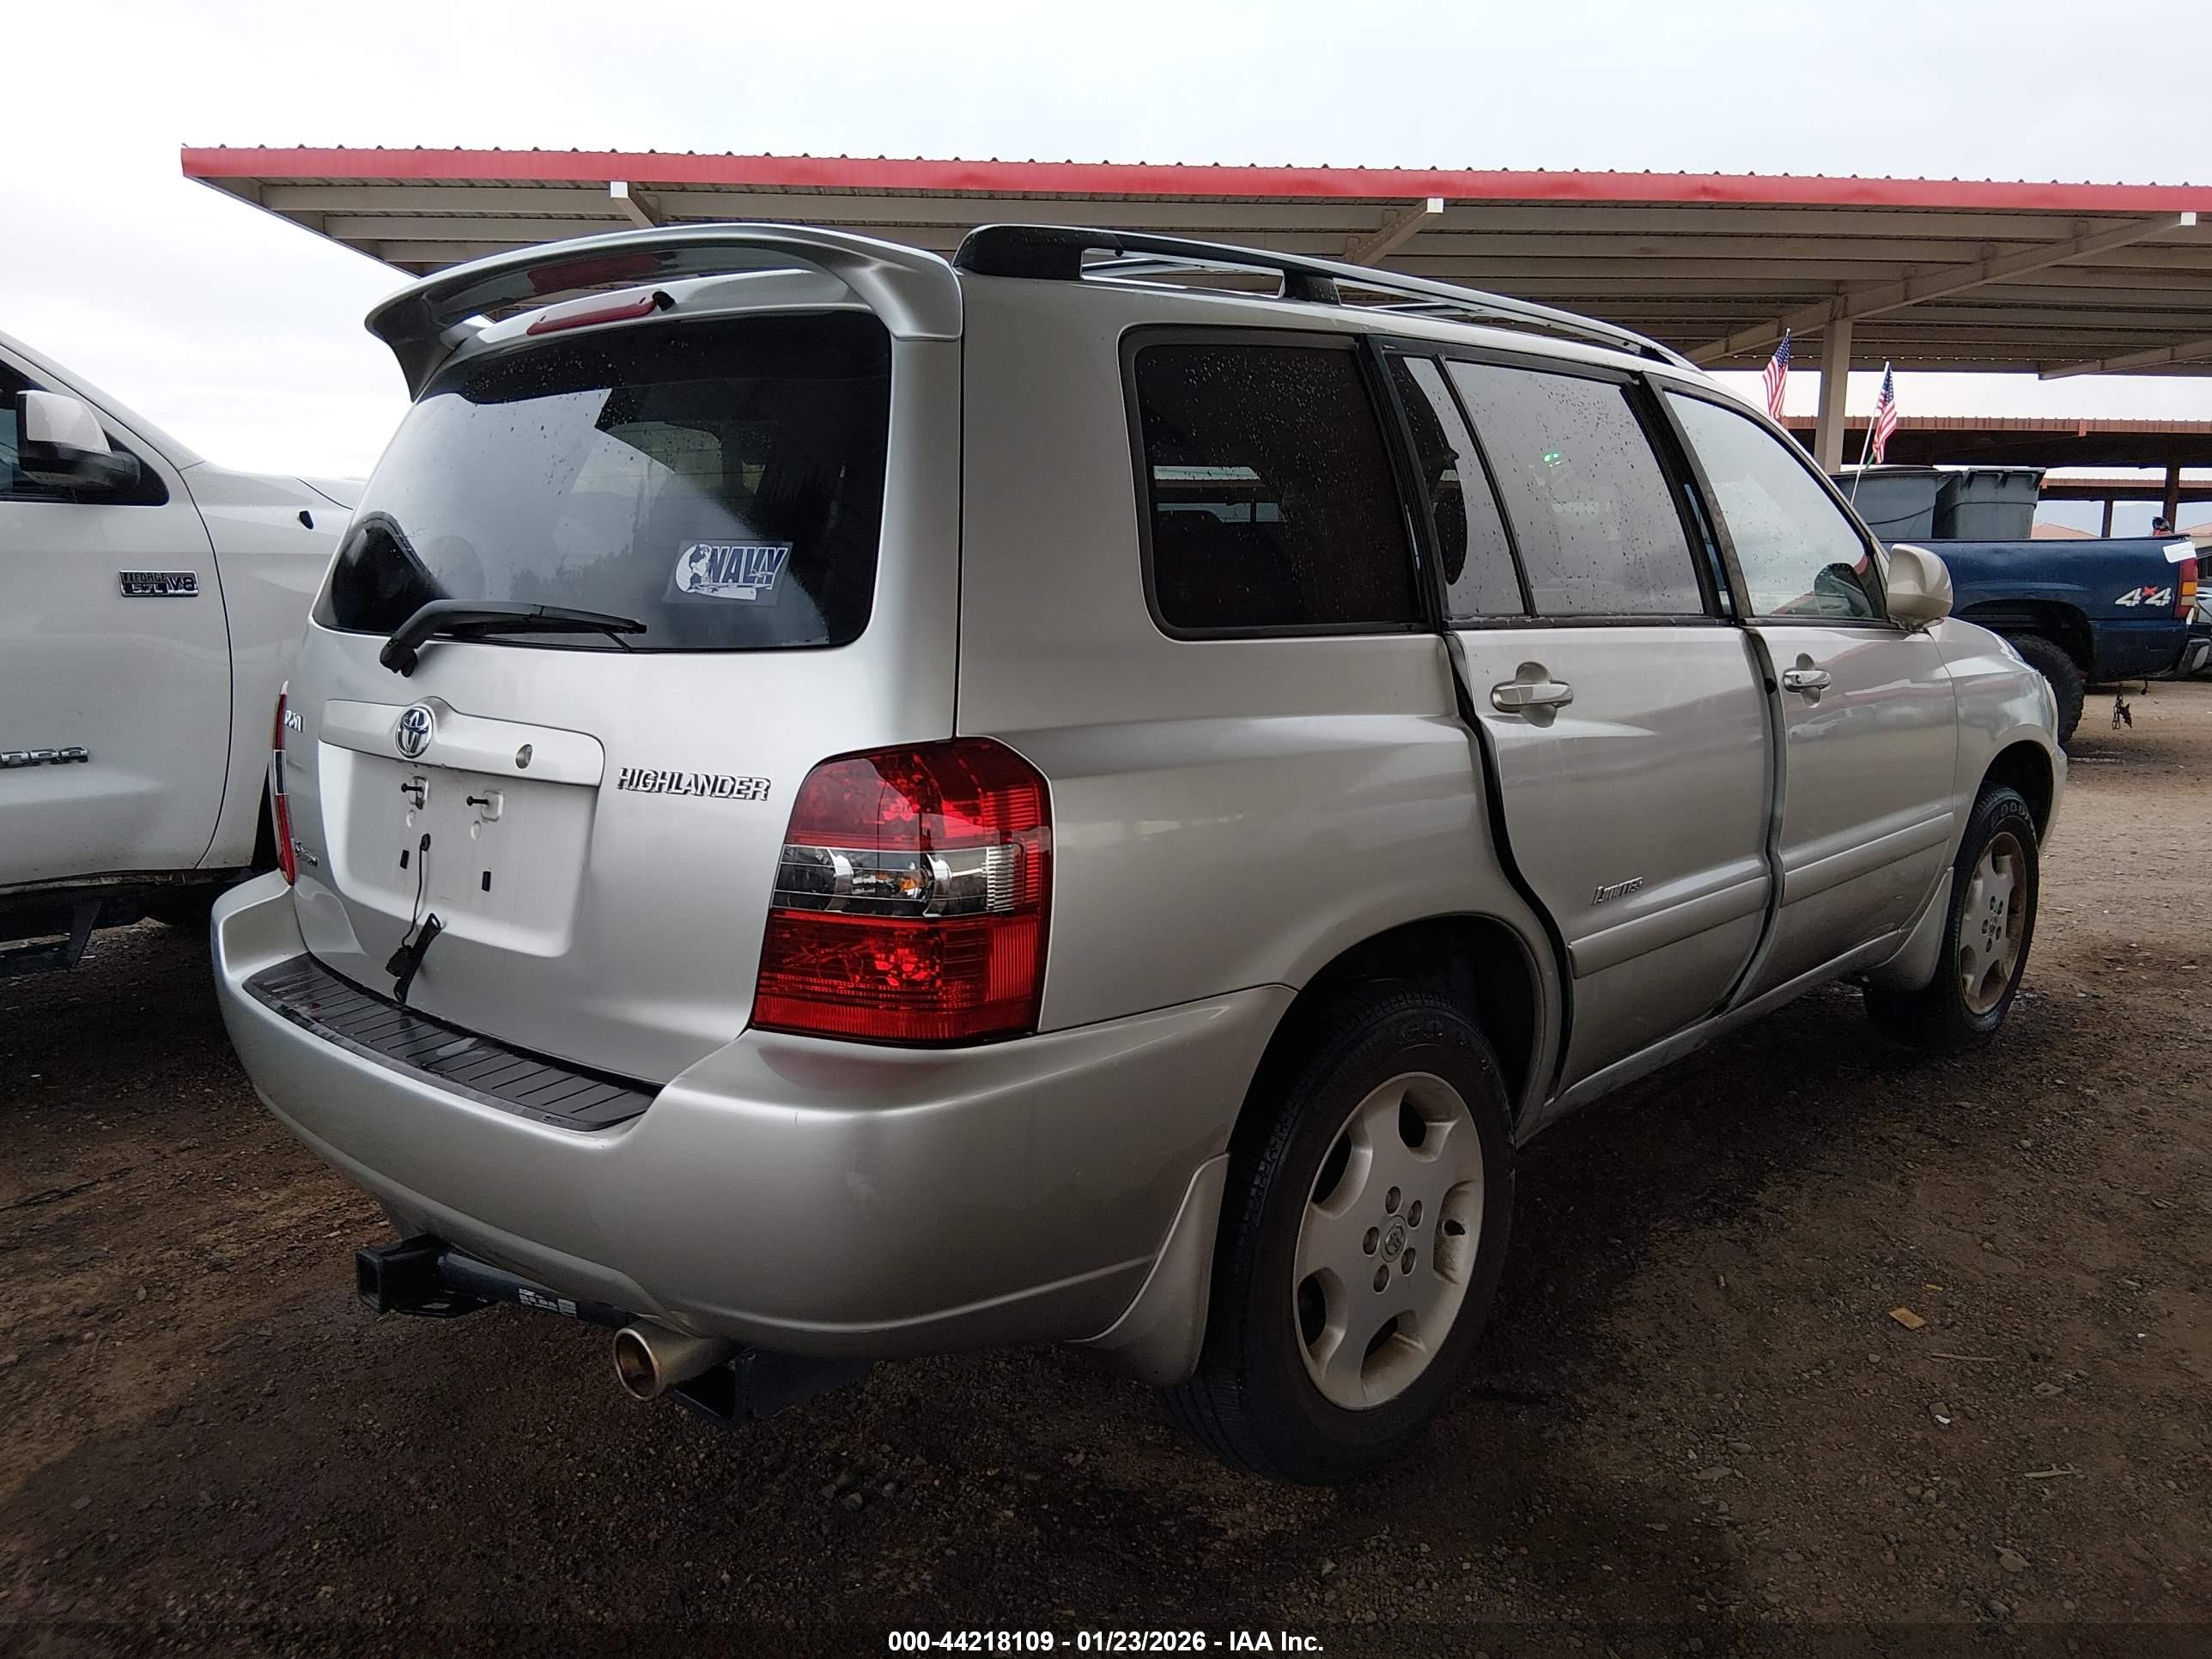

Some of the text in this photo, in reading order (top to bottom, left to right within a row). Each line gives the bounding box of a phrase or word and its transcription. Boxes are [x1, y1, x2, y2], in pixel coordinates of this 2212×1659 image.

[168, 576, 196, 592] V8
[708, 545, 788, 589] NAVY
[617, 767, 771, 802] HIGHLANDER
